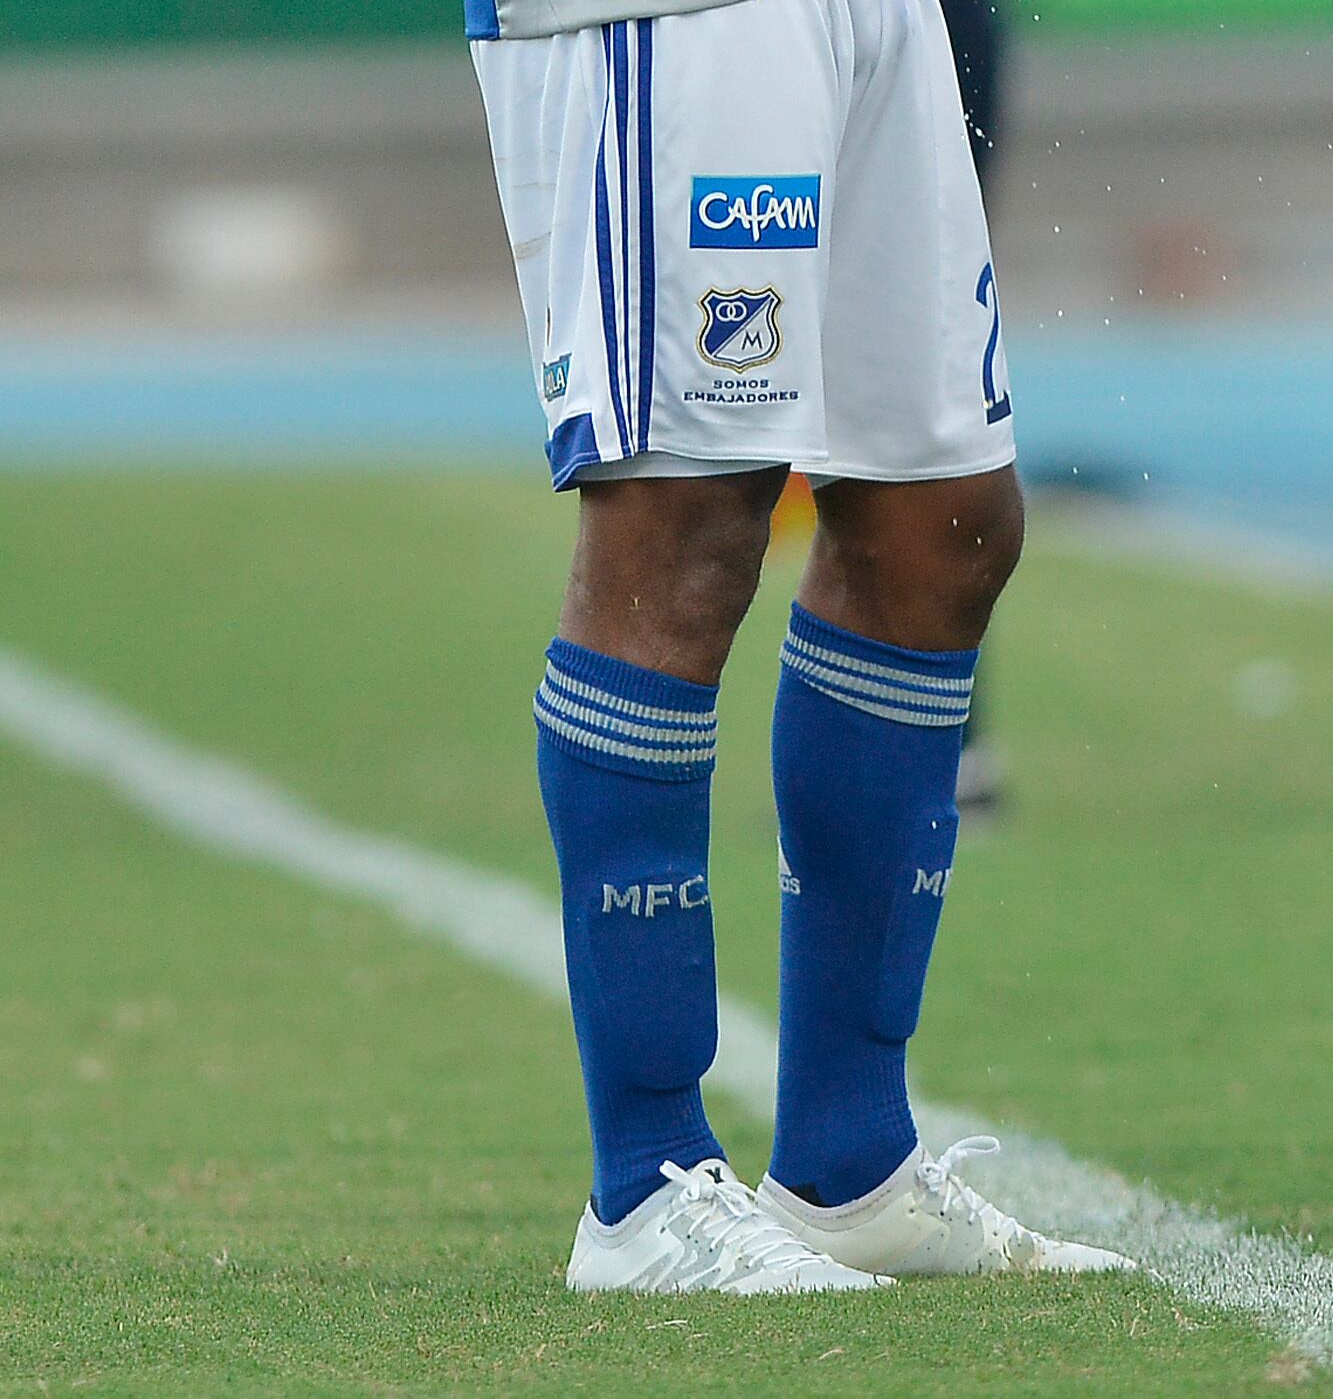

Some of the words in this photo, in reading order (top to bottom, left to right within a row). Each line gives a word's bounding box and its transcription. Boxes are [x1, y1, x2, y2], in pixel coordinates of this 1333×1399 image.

[740, 331, 763, 351] M
[976, 262, 1013, 425] 2
[713, 379, 770, 389] SOMOS
[683, 391, 800, 404] EMBAJADORES
[602, 875, 709, 918] MFC
